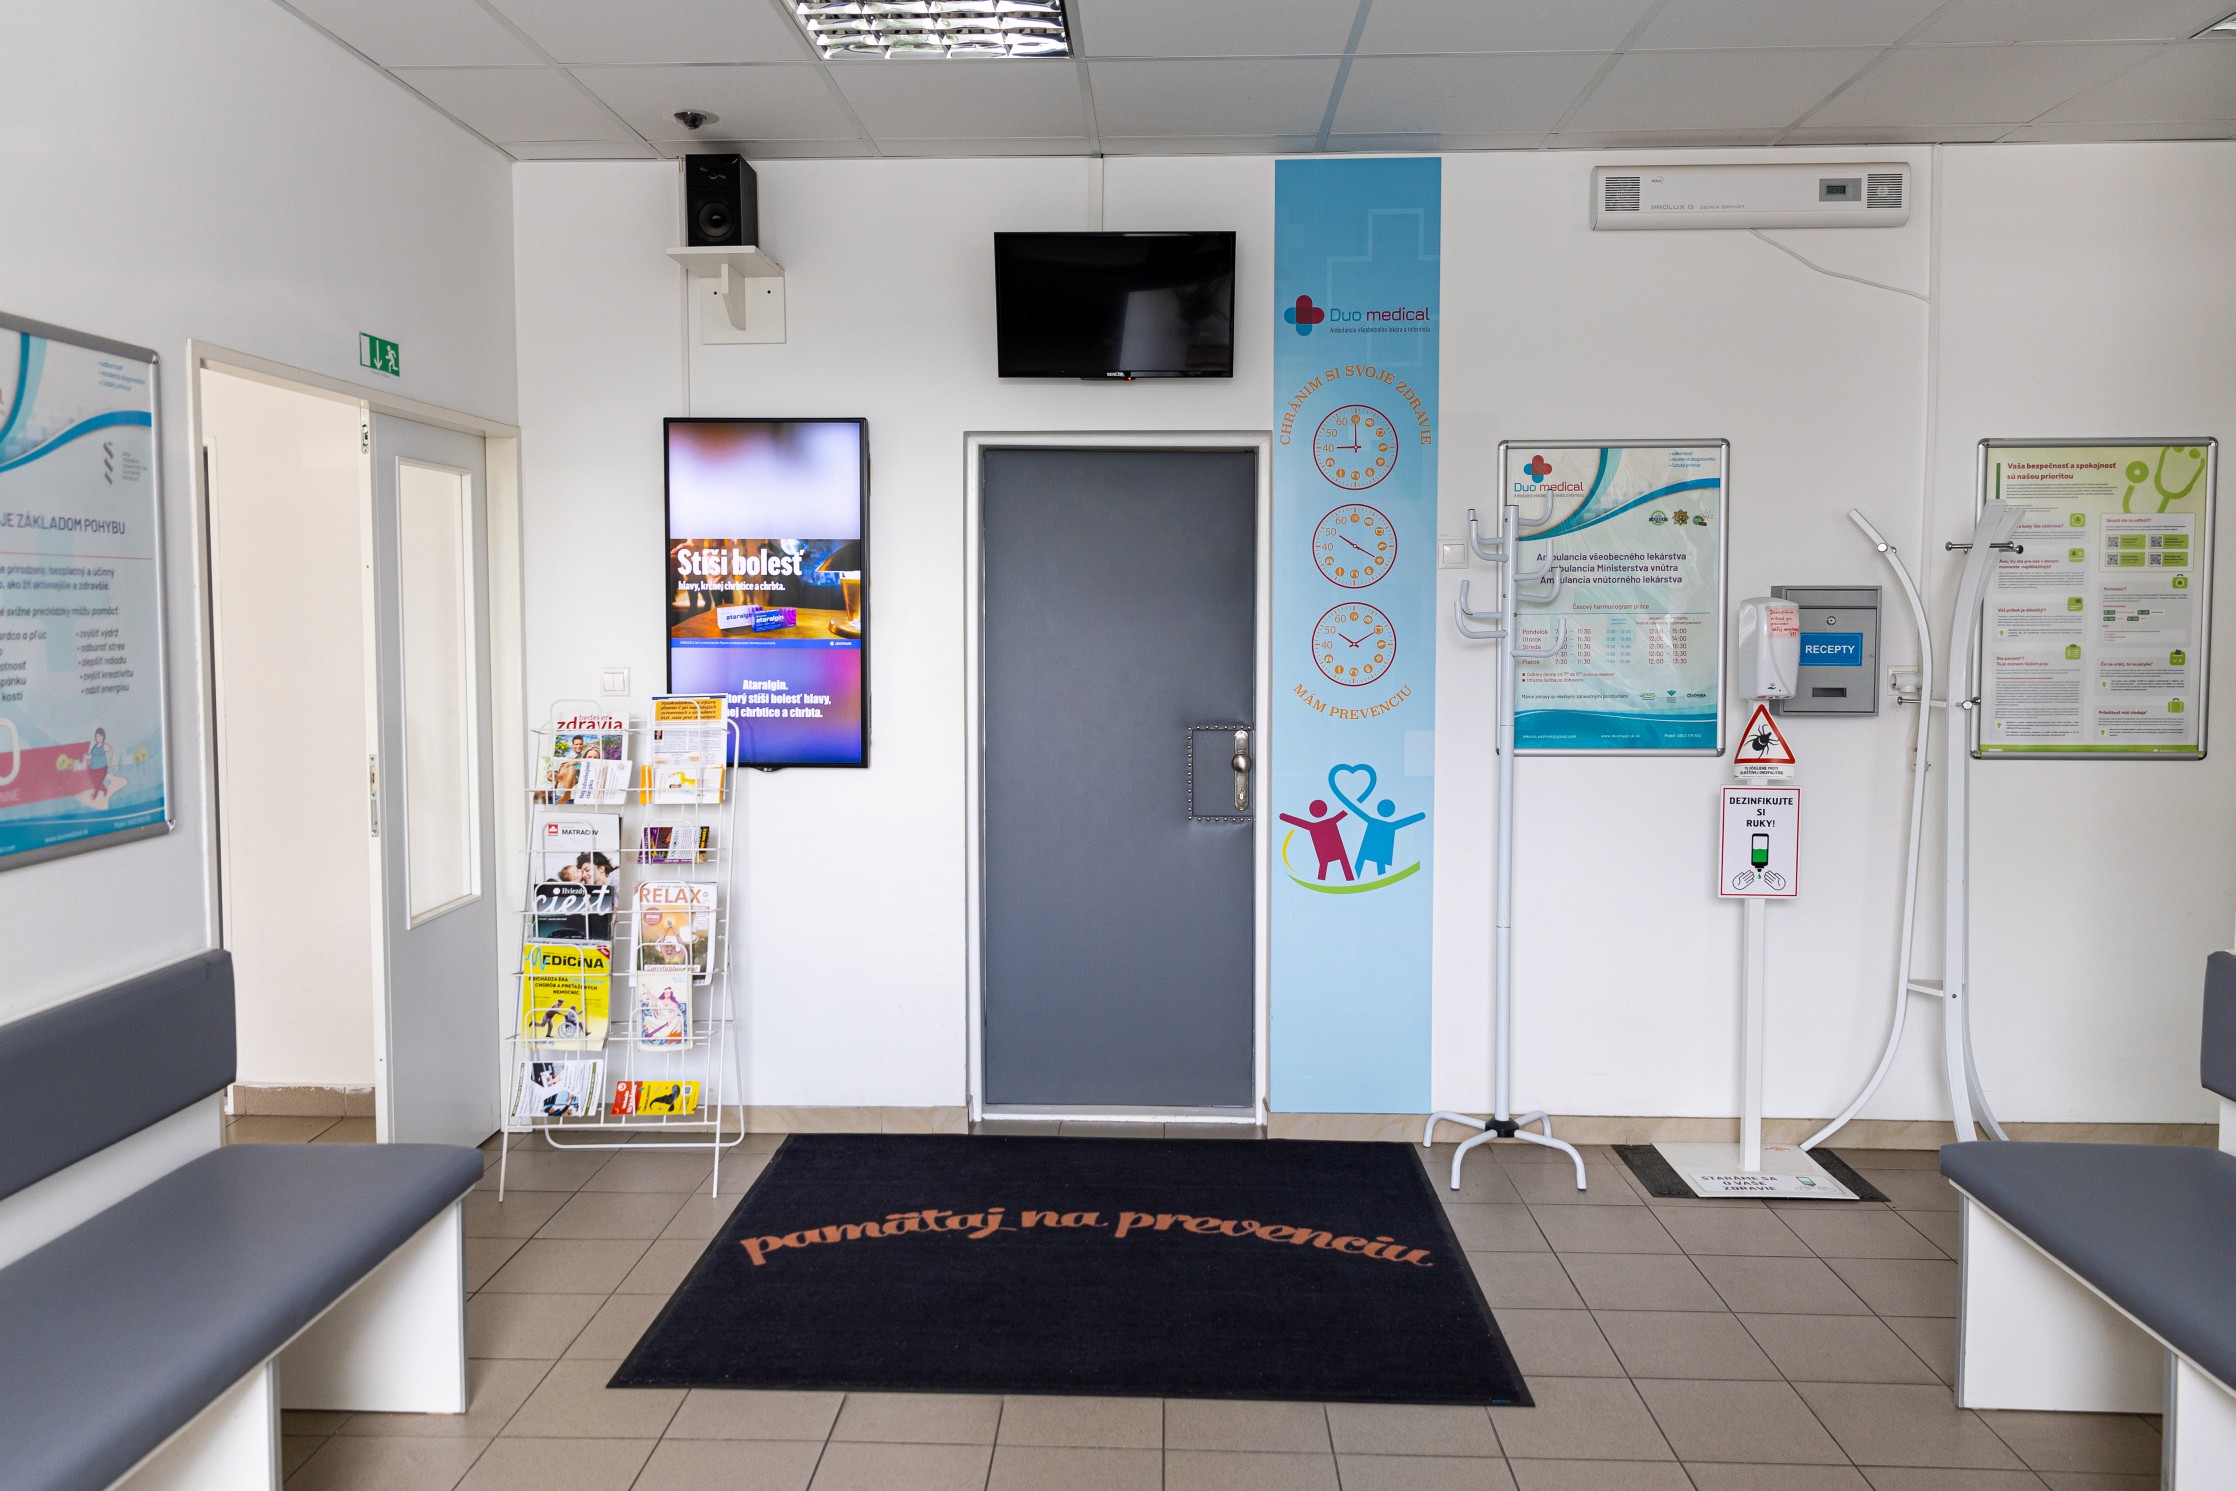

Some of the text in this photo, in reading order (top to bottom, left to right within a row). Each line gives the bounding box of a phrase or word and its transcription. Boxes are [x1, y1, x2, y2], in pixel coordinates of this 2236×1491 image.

[1331, 307, 1430, 322] Duo medical
[1279, 364, 1432, 446] CHRÁNIM SI SVOJE ZDRAVIE
[1335, 417, 1348, 426] 60
[1326, 428, 1338, 438] 50
[1322, 443, 1335, 453] 40
[2007, 462, 2026, 470] Vaša
[2026, 462, 2070, 470] bezpečnosť
[2075, 462, 2117, 471] spokojnosť
[2040, 473, 2074, 481] prioritou
[1514, 481, 1584, 492] Duo medical
[16, 511, 82, 532] ZÁKLADOM
[84, 519, 126, 535] POHYBU
[1335, 516, 1348, 525] 60
[1325, 527, 1337, 537] 50
[1321, 542, 1334, 552] 40
[1589, 552, 1645, 561] všeobecného
[1646, 552, 1687, 561] lekárstva
[677, 548, 805, 576] Stíši bolesť
[1596, 564, 1649, 573] Ministerstva
[1650, 564, 1679, 572] vnútra
[1540, 575, 1683, 584] Amulancia vnútorného lekárstva
[678, 581, 701, 592] hlavy,
[724, 580, 754, 591] chrbtice
[754, 583, 760, 591] a
[760, 580, 786, 591] chrbta.
[1572, 602, 1592, 610] Časový
[1593, 602, 1633, 610] harmonogram
[755, 614, 785, 624] ataralgin
[1334, 614, 1347, 624] 60
[1324, 625, 1336, 635] 50
[108, 643, 125, 651] stres
[1320, 640, 1333, 650] 40
[1805, 645, 1855, 654] RECEPTY
[742, 679, 789, 692] Ataralgin.
[727, 692, 747, 705] torý
[770, 692, 803, 704] bolesť
[803, 693, 832, 706] hlavy,
[1292, 683, 1413, 720] MÁM PREVENCIU
[740, 706, 781, 718] chrbtice
[781, 709, 789, 718] a
[789, 706, 823, 718] chrbta.
[556, 716, 623, 732] zdravia
[1729, 796, 1794, 806] DEZINFIKUJTE
[1756, 808, 1766, 816] SI
[1746, 819, 1776, 828] RUKY!
[640, 887, 702, 904] RELAX
[740, 1206, 1434, 1268] pamätaj na prevenciu
